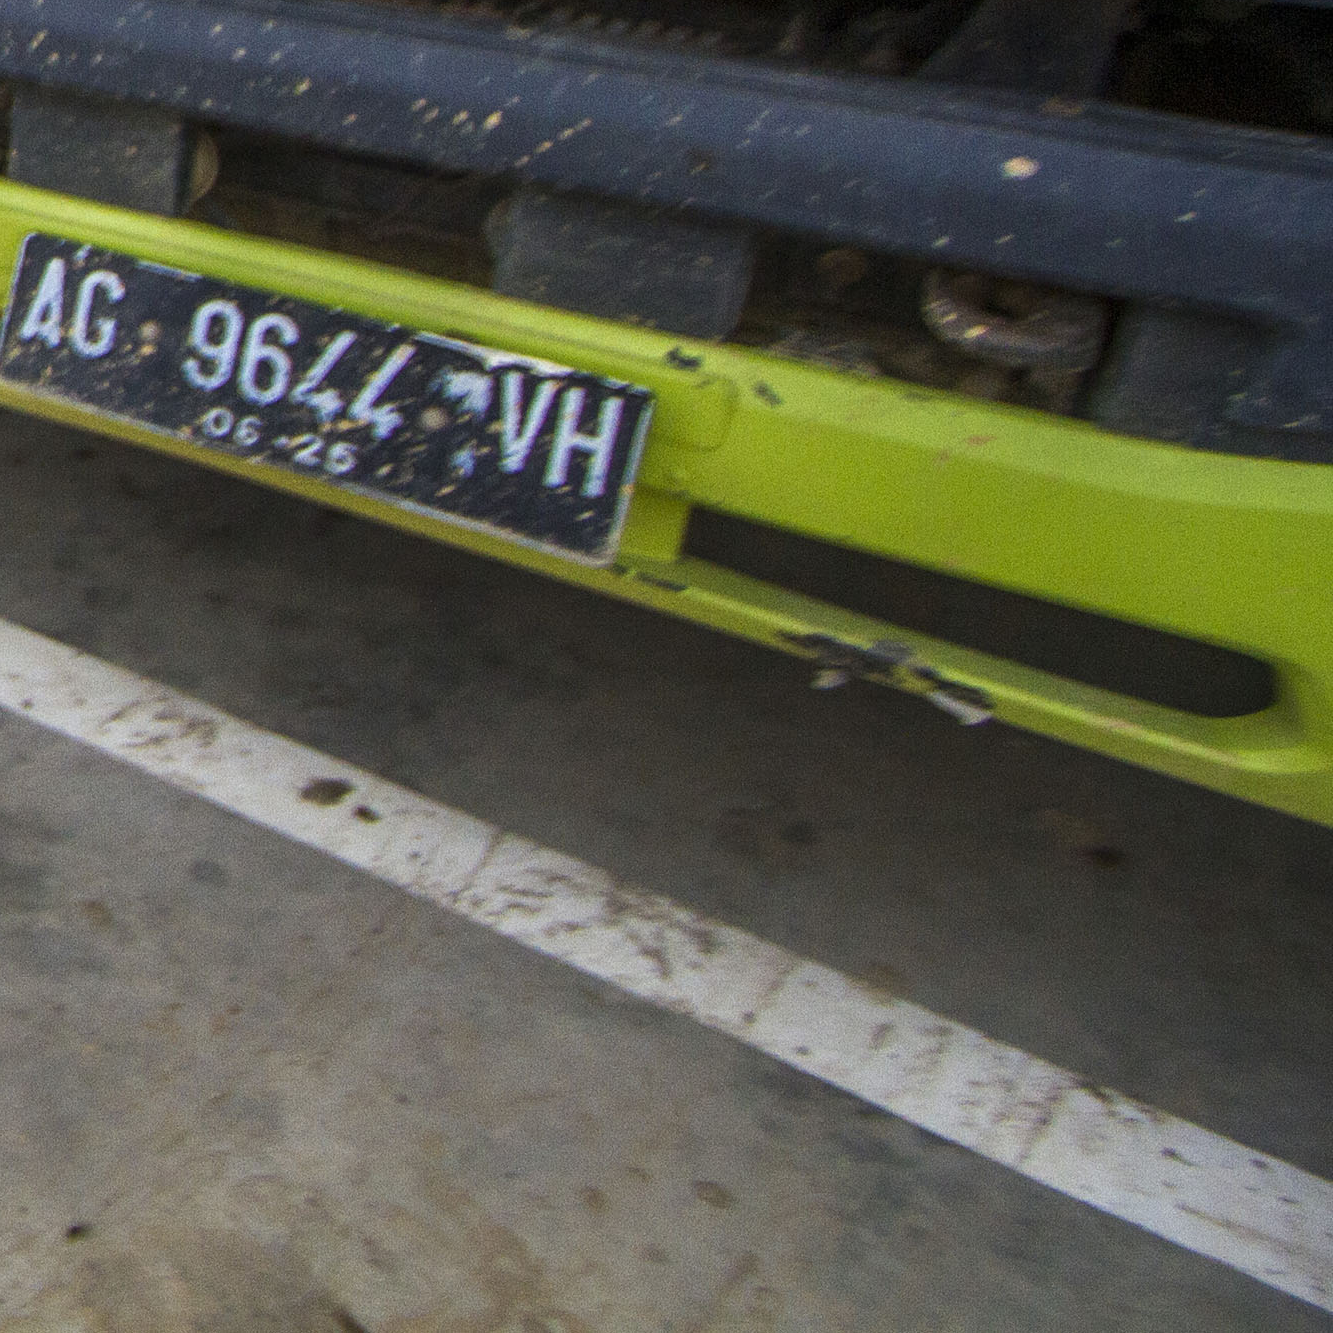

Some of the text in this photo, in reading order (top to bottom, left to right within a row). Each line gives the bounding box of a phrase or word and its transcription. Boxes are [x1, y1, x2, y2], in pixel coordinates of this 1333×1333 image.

[20, 257, 623, 498] AG 9644 VH
